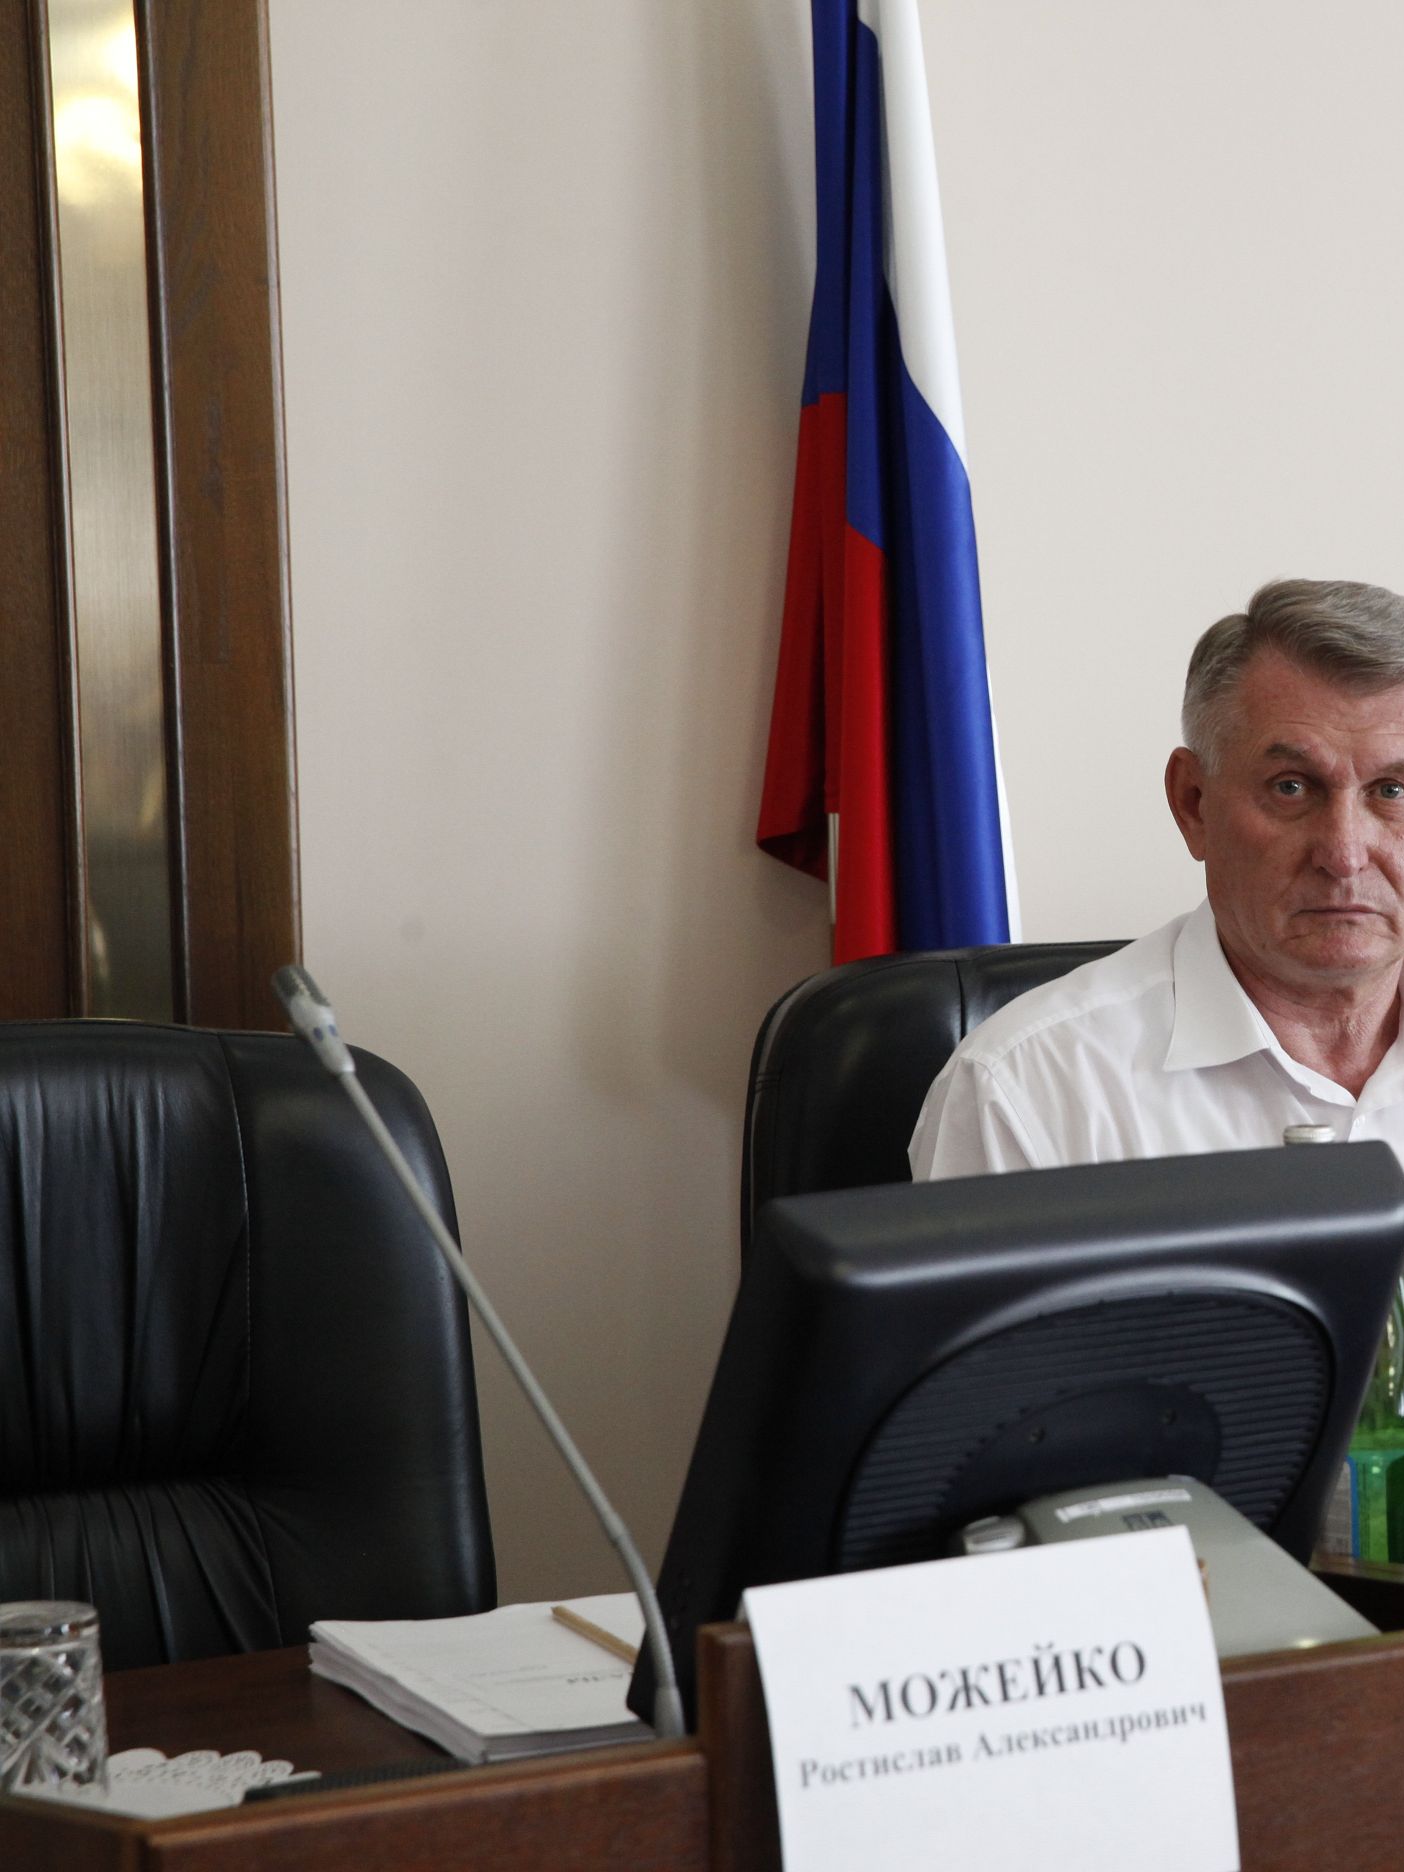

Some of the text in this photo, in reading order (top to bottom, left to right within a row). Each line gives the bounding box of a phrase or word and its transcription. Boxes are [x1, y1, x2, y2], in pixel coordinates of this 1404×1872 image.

[849, 1640, 1147, 1728] МОЖЕЙКО
[801, 1702, 1207, 1789] Ростислав Александрович
